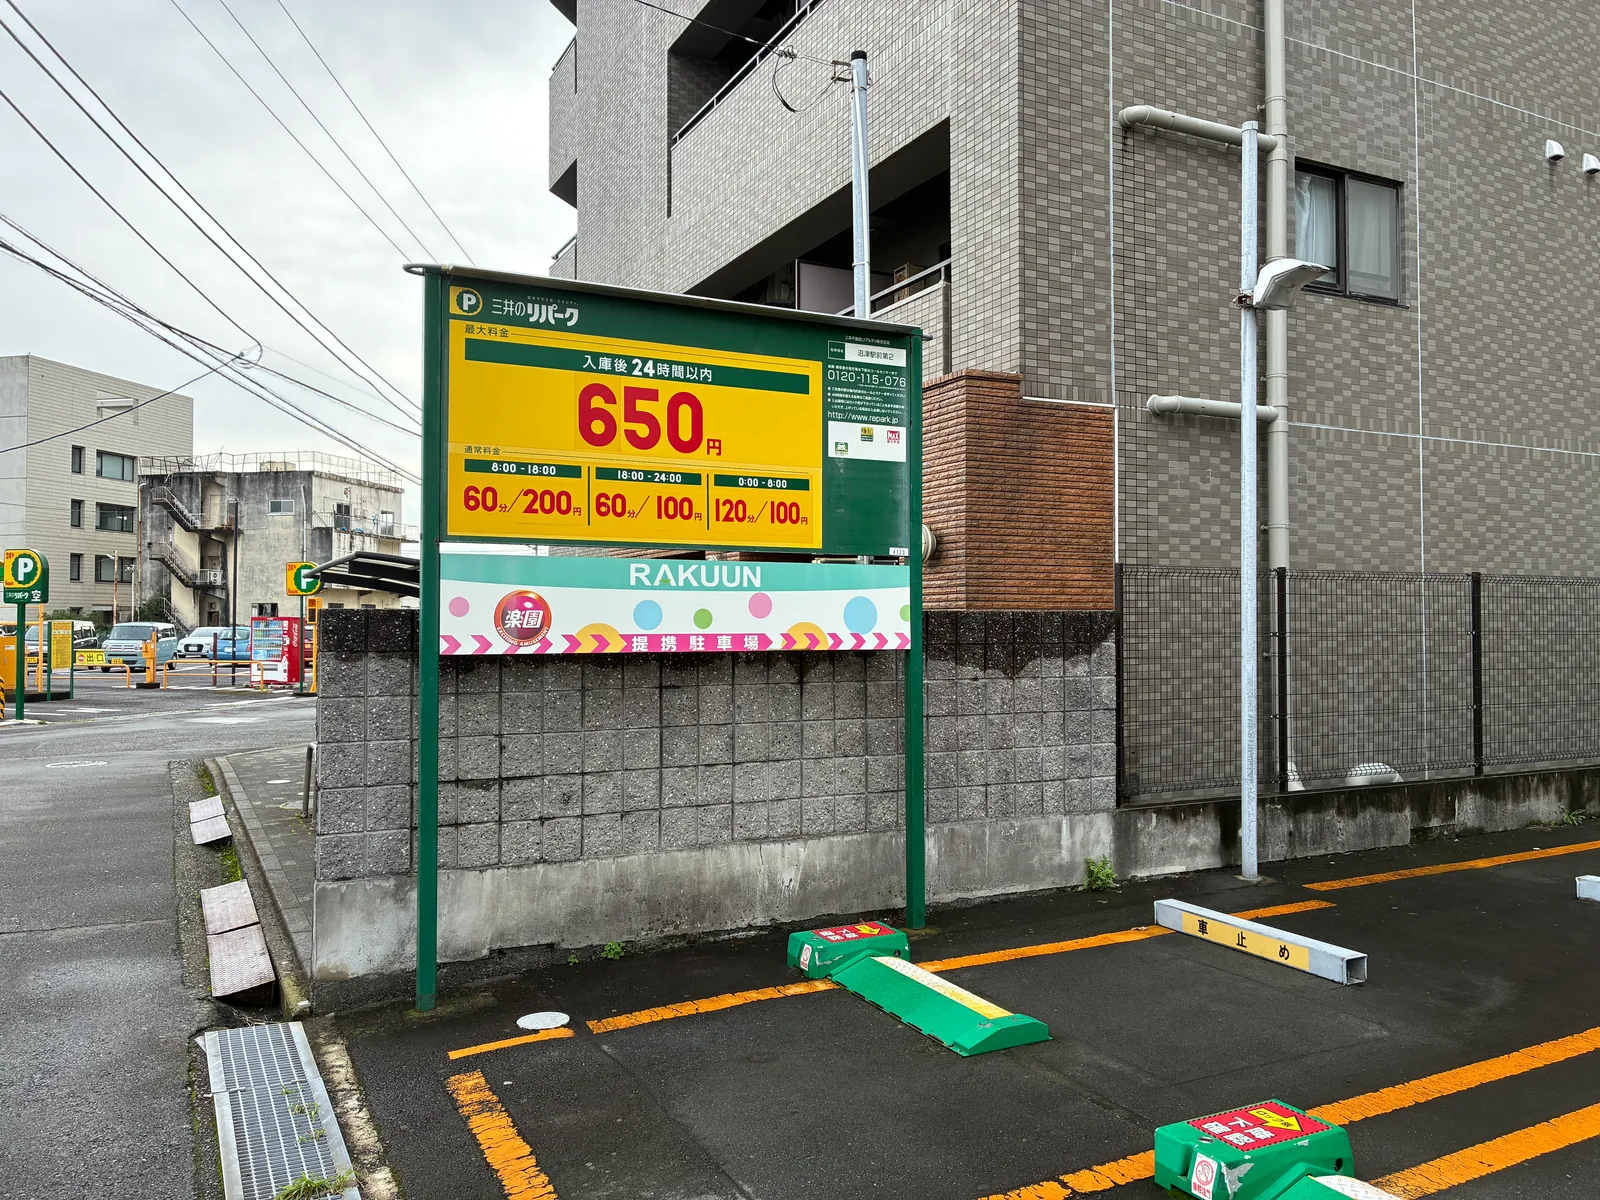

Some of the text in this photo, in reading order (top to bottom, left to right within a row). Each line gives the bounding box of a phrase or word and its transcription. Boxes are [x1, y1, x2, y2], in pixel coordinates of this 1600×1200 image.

[491, 298, 579, 327] 三井のリパーク
[464, 323, 510, 338] 最大料金
[582, 354, 713, 383] 入庫後24時間以内
[827, 370, 907, 388] 0120-115-076
[827, 411, 899, 424] http://www.repark.jp
[464, 444, 501, 455] 通常料金
[629, 563, 762, 588] RAKUUN
[31, 590, 41, 601] 空
[504, 608, 544, 629] 楽園
[497, 626, 549, 646] EXCITING AMUSEMENT
[631, 635, 760, 652] 提携駐車場
[86, 654, 104, 663] 出口
